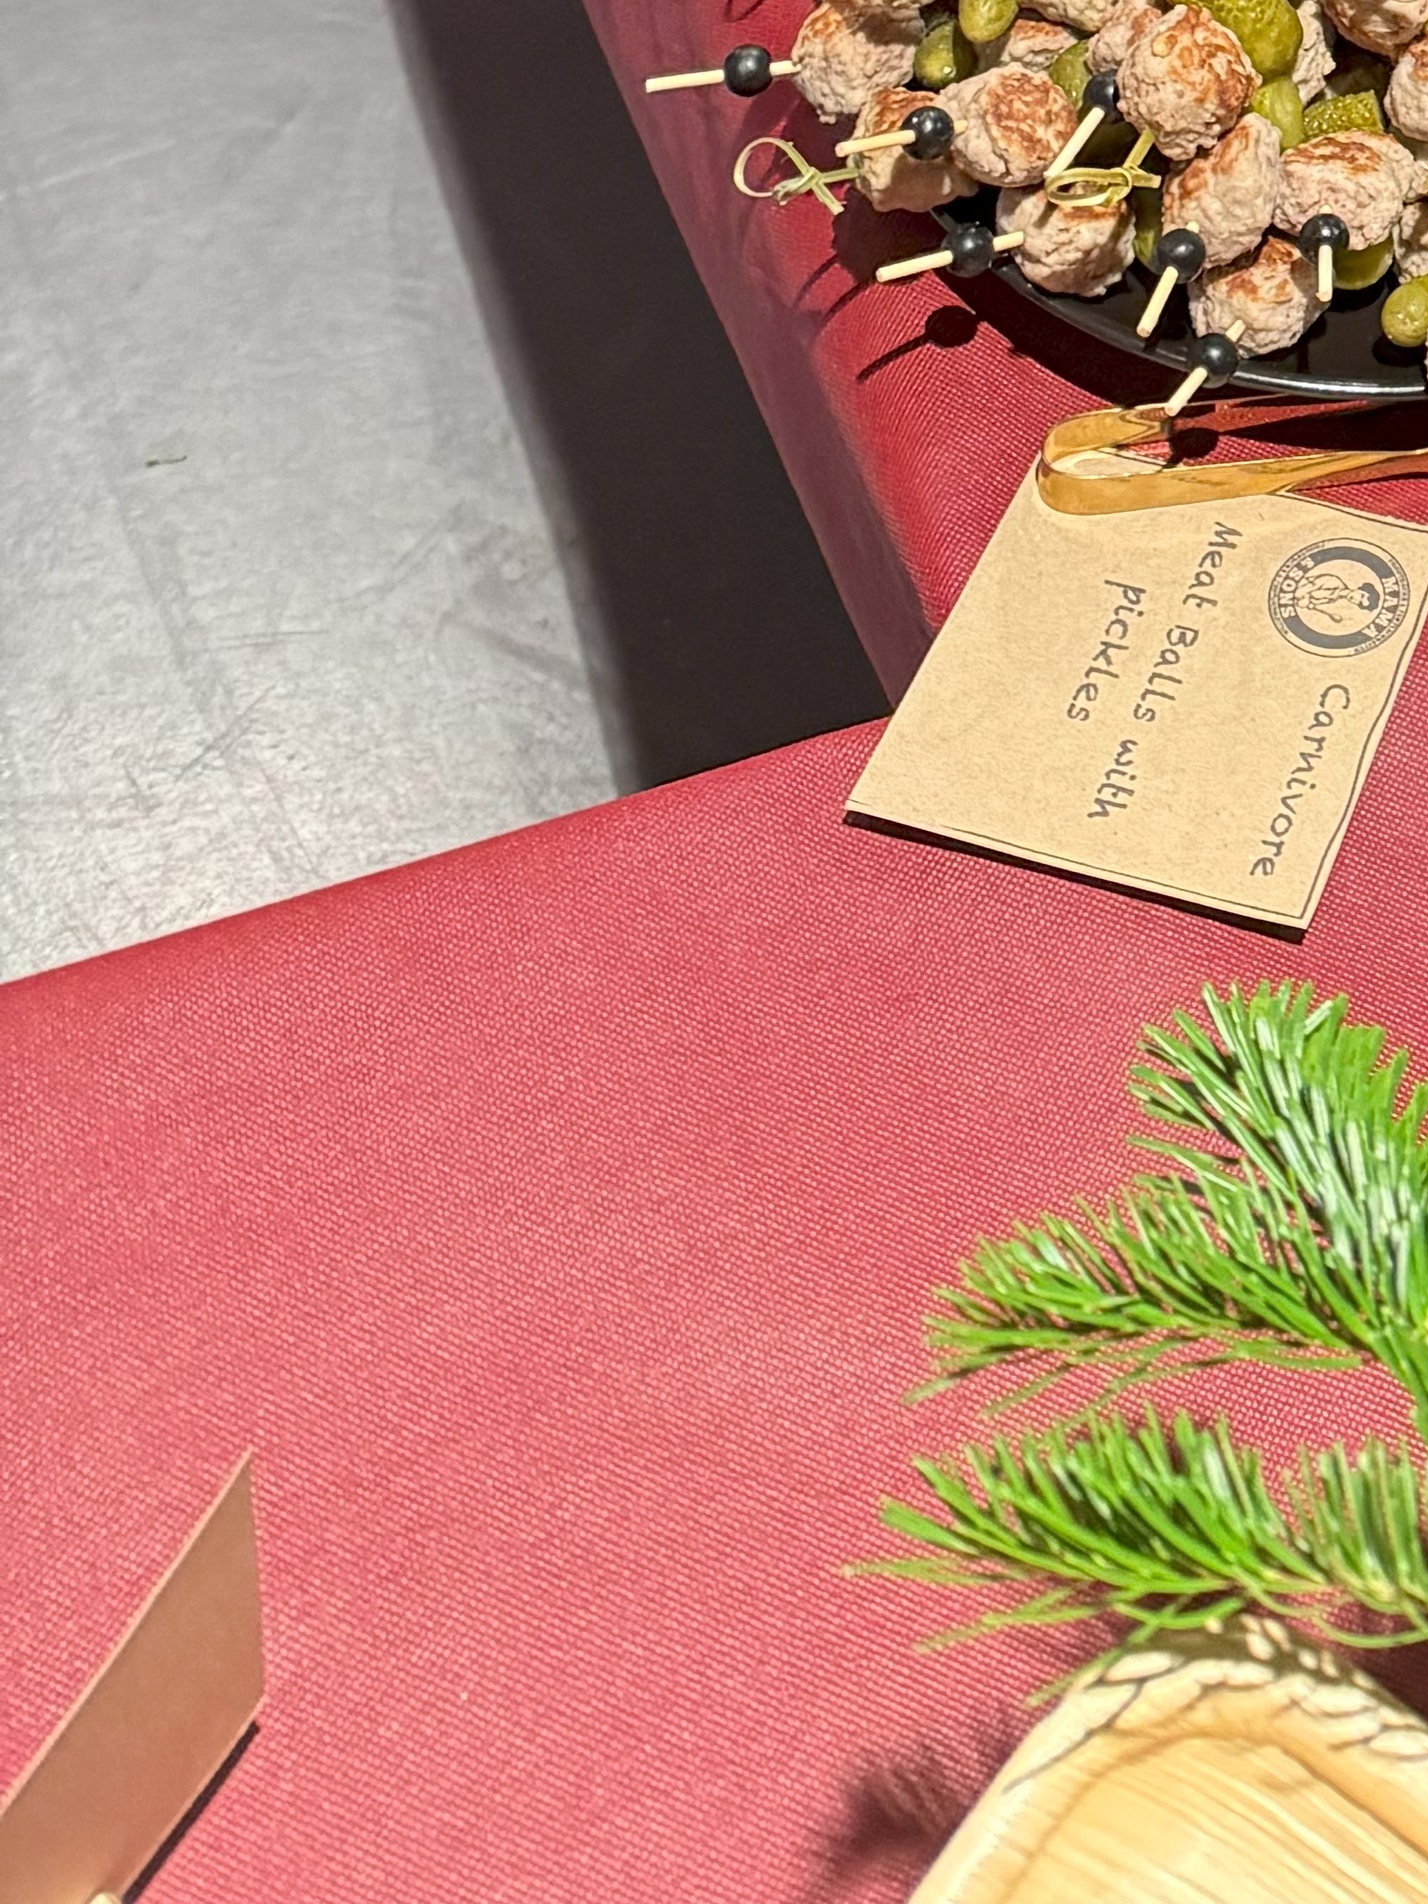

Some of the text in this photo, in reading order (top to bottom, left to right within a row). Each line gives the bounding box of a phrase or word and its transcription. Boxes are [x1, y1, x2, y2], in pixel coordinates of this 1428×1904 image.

[1278, 567, 1303, 619] SONS
[1361, 575, 1399, 638] MAMA
[1086, 521, 1245, 820] Meat Balls with
[1249, 681, 1351, 880] Carnivore
